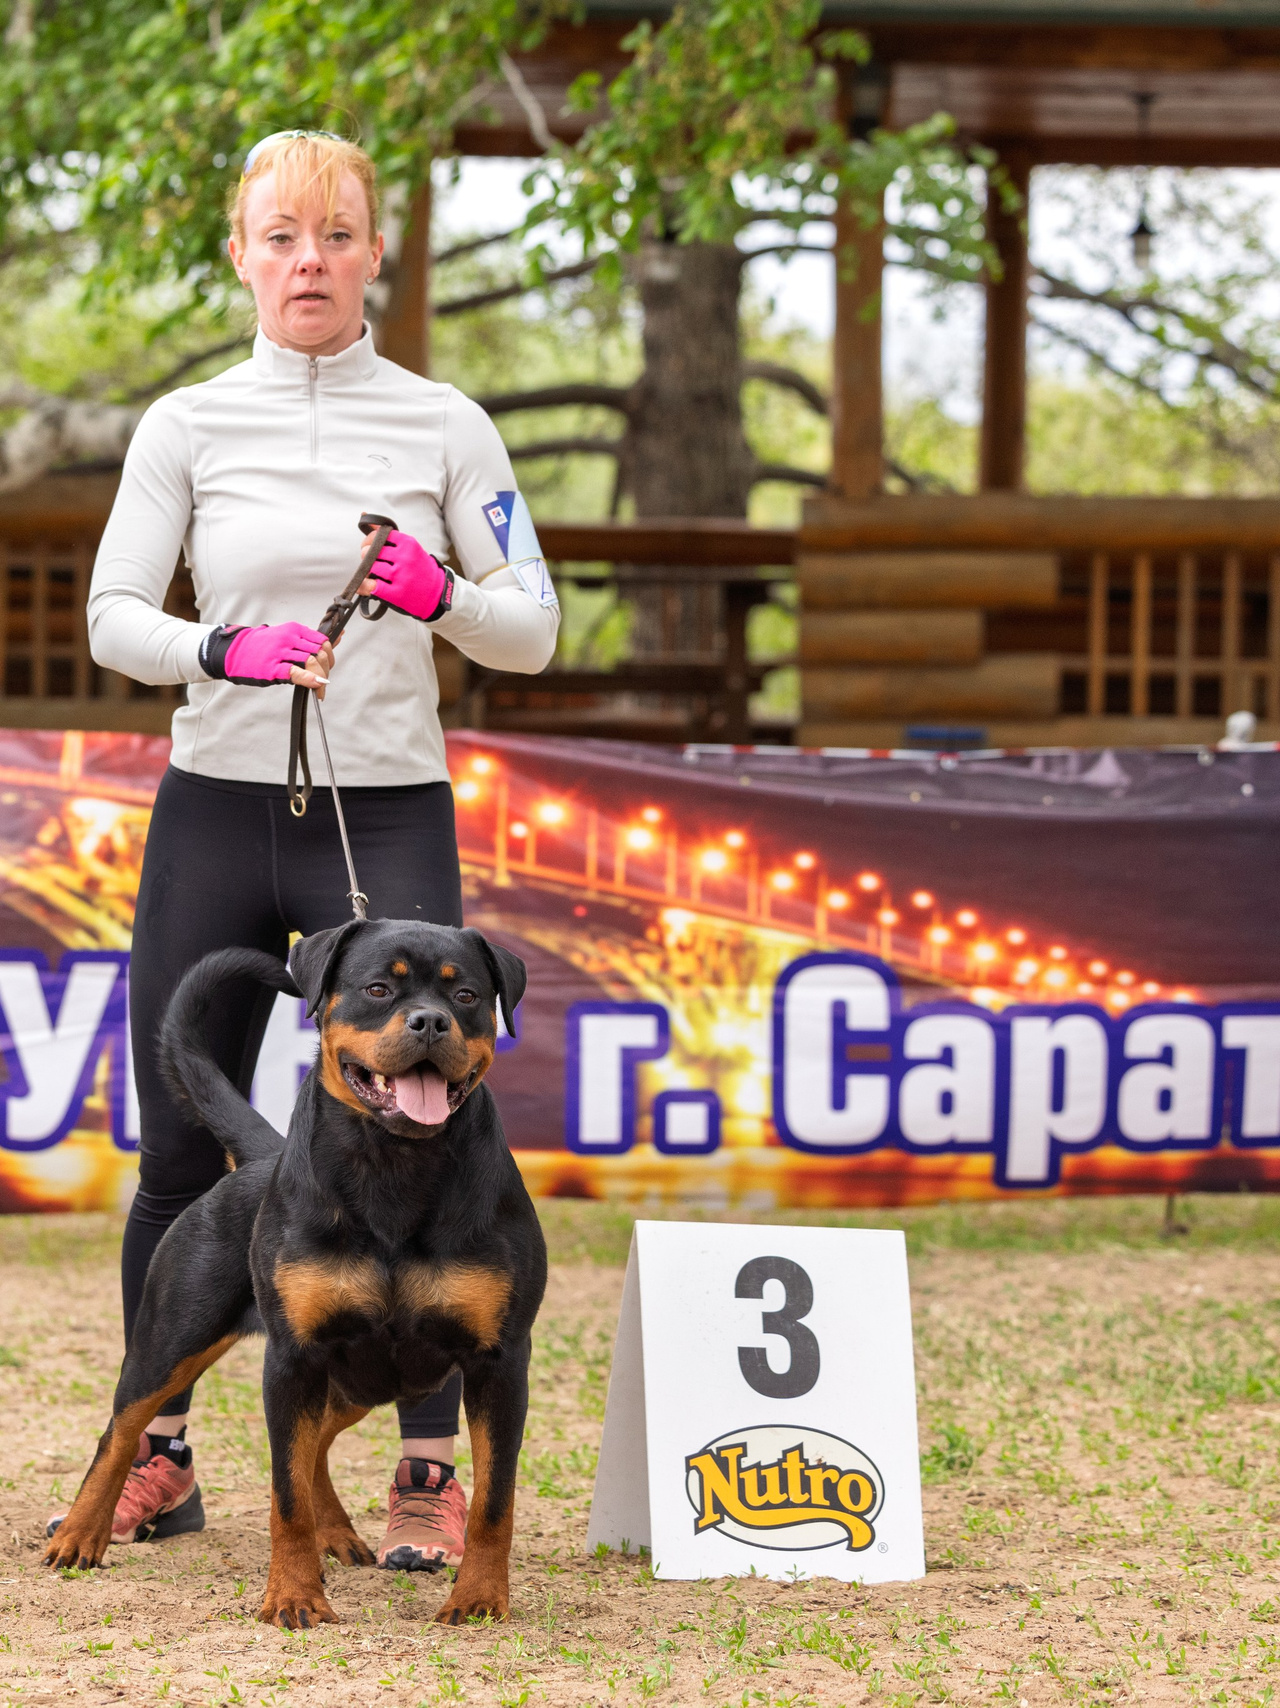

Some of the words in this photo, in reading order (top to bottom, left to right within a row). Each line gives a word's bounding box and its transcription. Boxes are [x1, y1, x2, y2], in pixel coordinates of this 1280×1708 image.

[578, 1011, 711, 1146] г.
[734, 1255, 821, 1400] 3
[685, 1442, 876, 1551] Nutro
